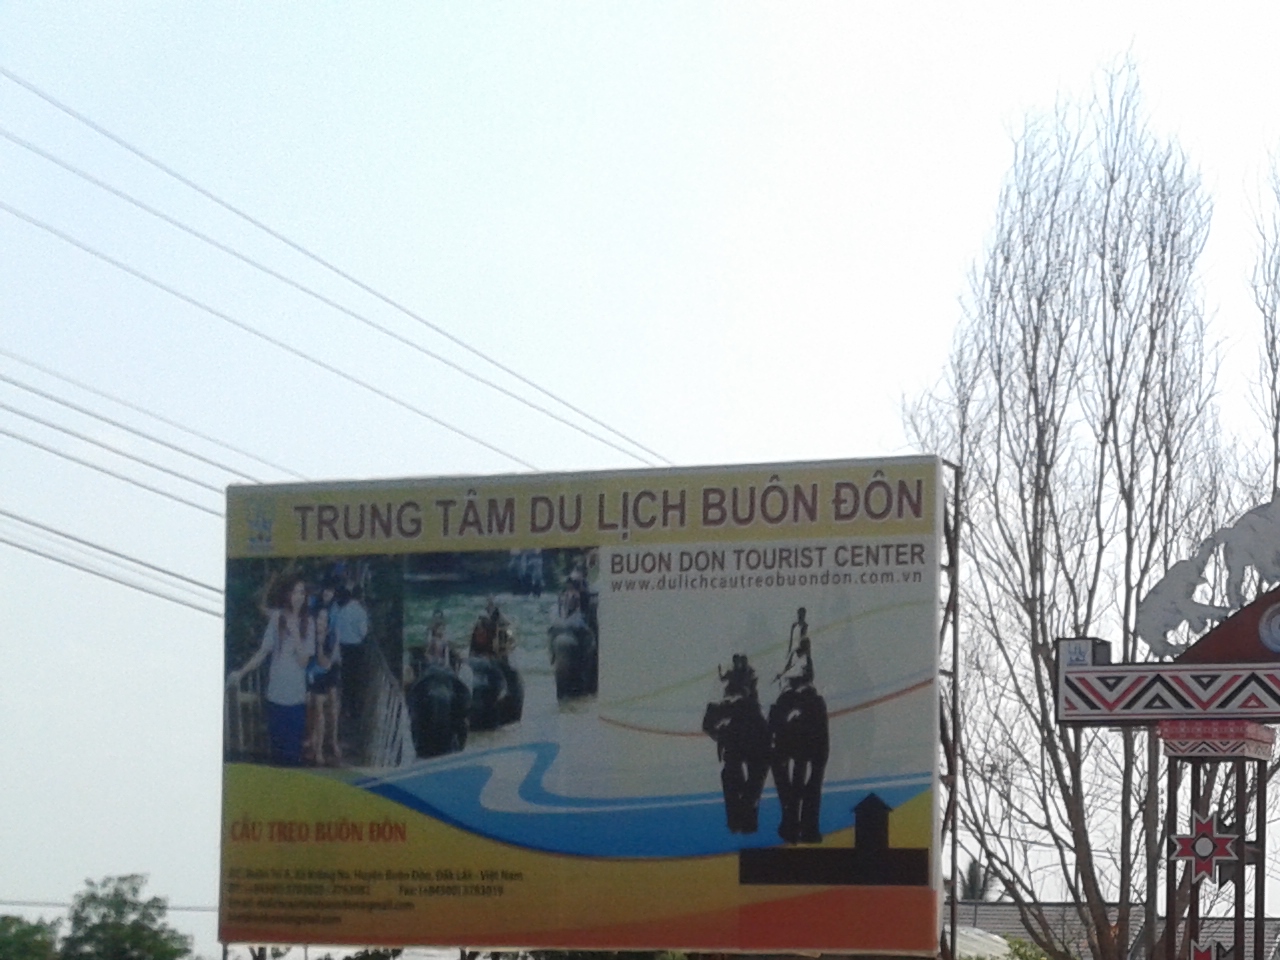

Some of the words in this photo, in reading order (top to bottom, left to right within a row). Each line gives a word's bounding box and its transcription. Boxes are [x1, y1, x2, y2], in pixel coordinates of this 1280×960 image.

[294, 501, 422, 542] TRUNG
[436, 488, 515, 537] TÂM
[530, 494, 582, 533] DU
[598, 489, 686, 541] LỊCH
[702, 474, 818, 528] BUÔN
[832, 469, 923, 522] ĐÔN
[611, 551, 672, 574] BUON
[679, 550, 726, 572] DON
[733, 546, 828, 571] TOURIST
[834, 543, 926, 567] CENTER
[611, 570, 923, 592] www.dulichcautreobuondon.com.vn
